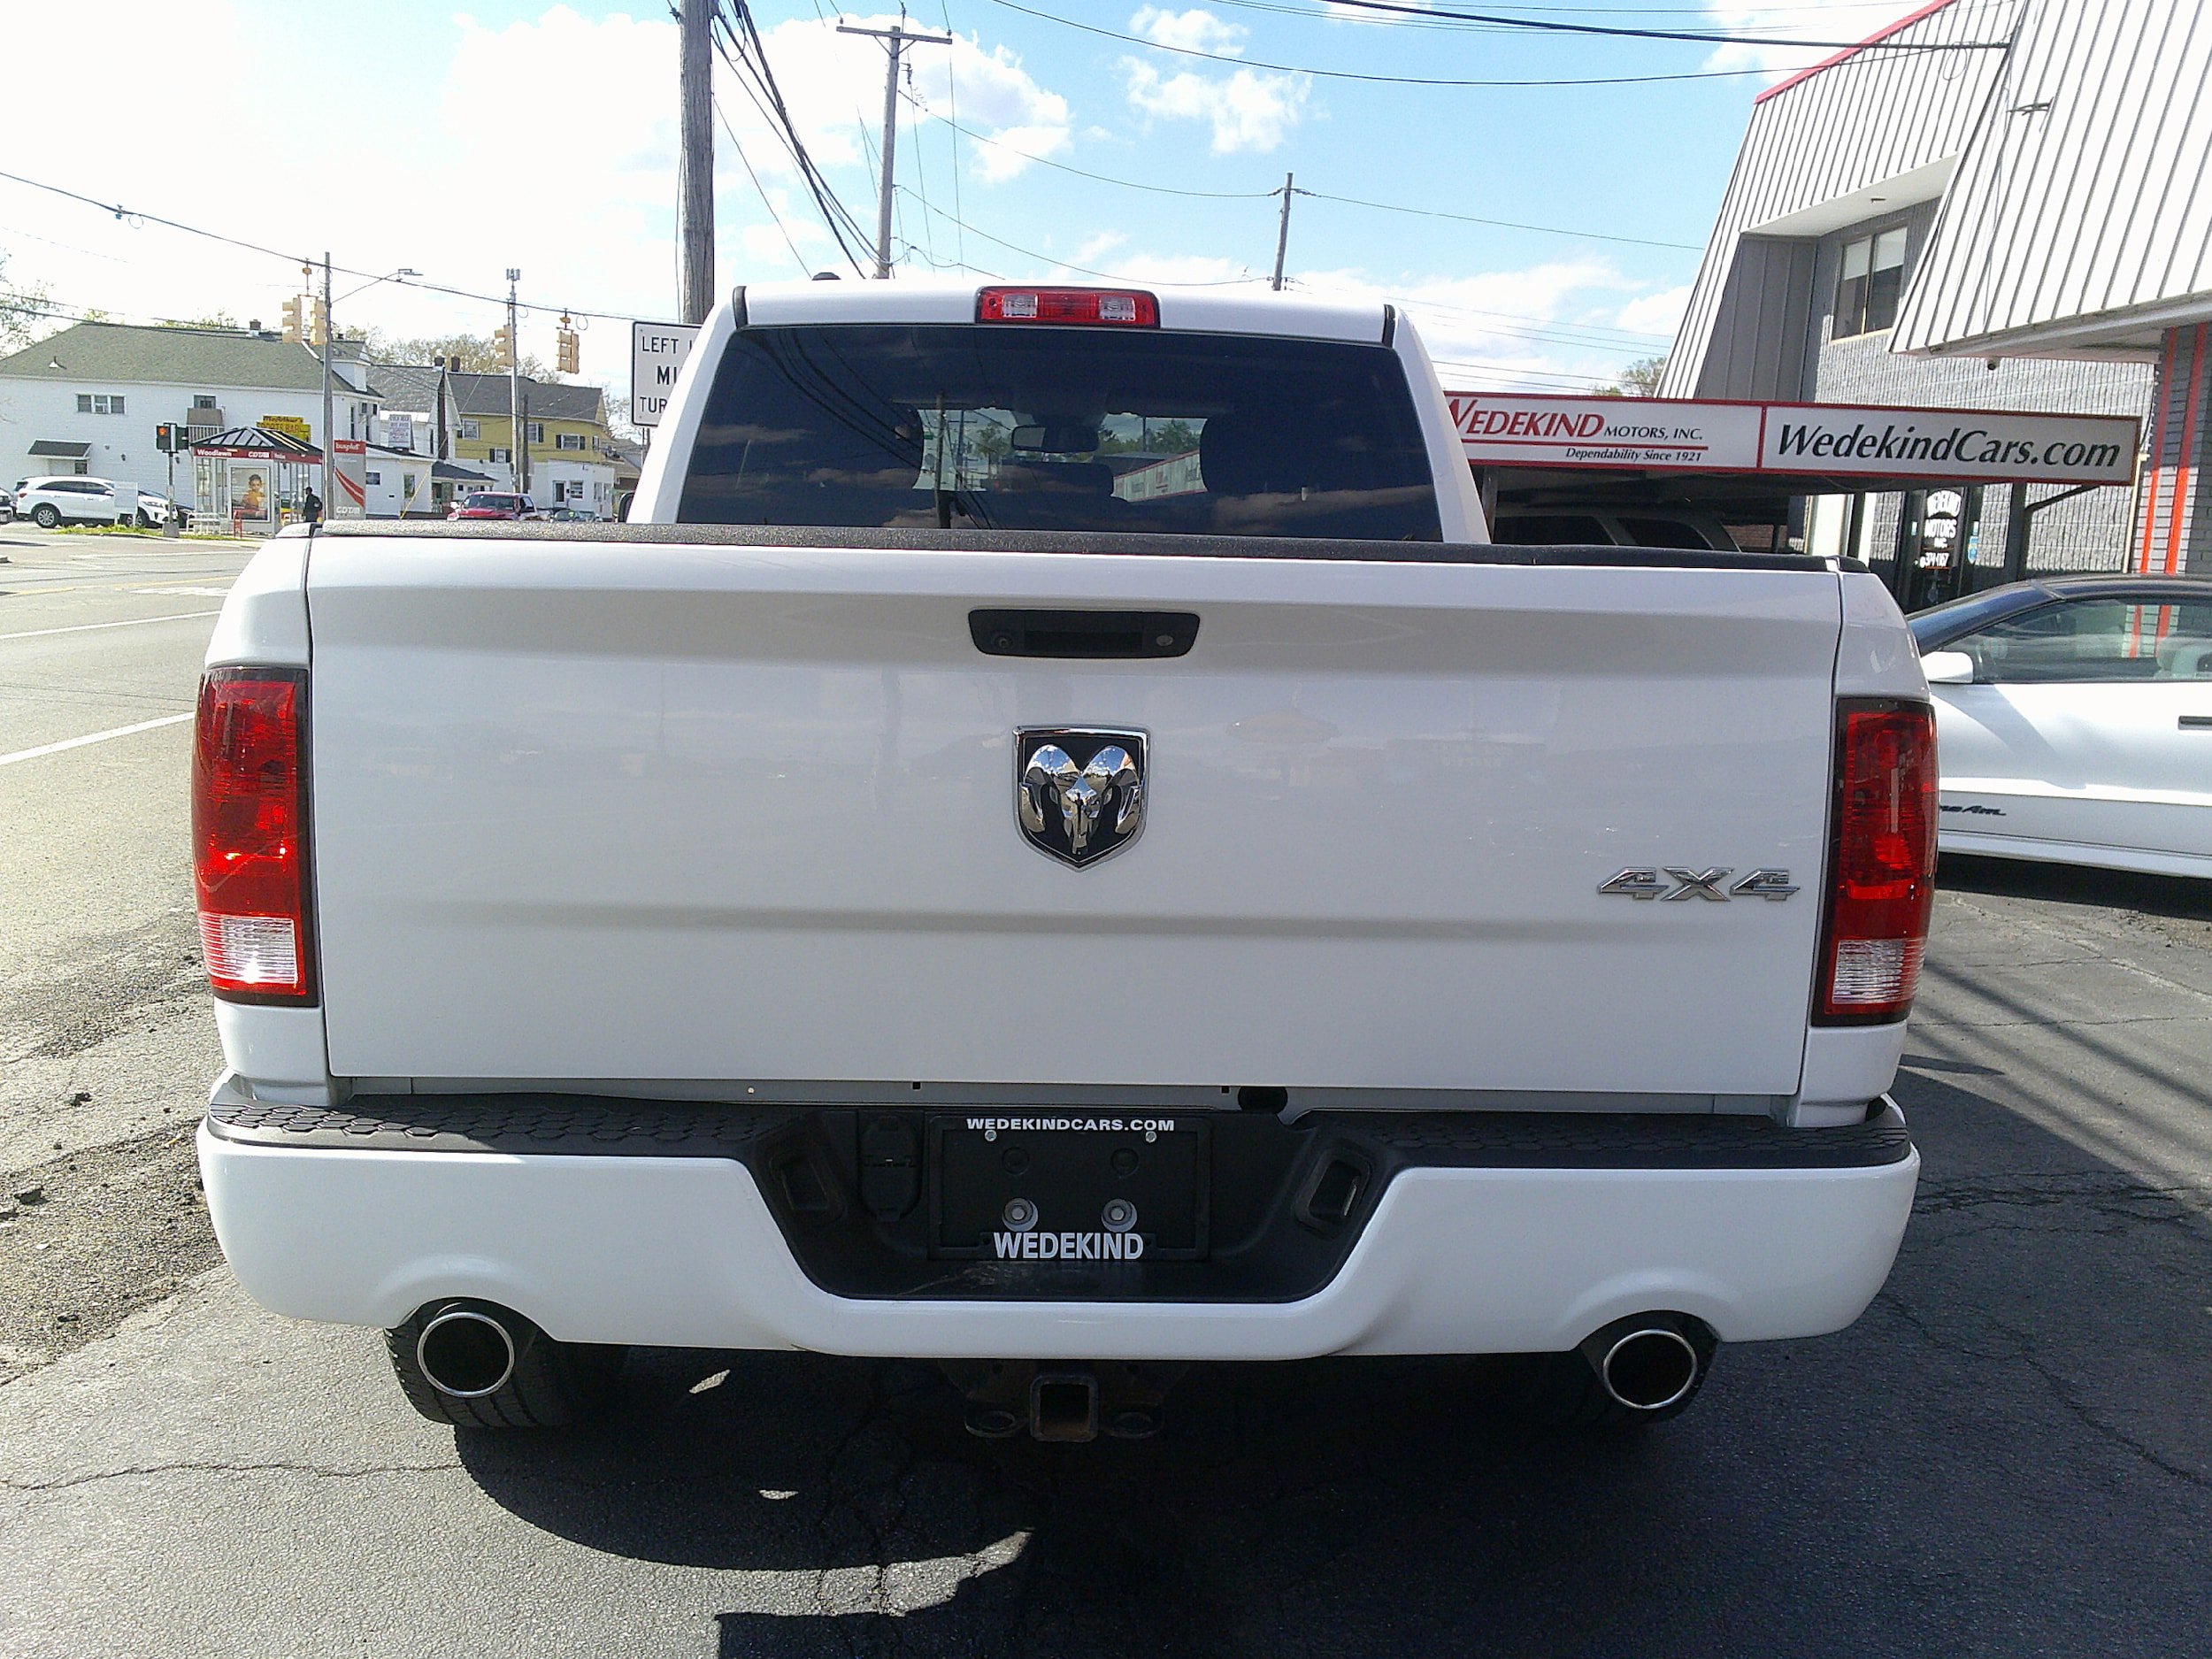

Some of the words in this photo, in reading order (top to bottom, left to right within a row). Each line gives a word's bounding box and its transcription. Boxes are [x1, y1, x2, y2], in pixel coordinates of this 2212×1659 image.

[641, 336, 679, 354] LEFT
[639, 396, 668, 414] TUR
[1603, 426, 1669, 441] MOTORS,
[1673, 428, 1703, 441] INC.
[196, 449, 232, 457] Woodlawn
[1565, 447, 1641, 462] Dependability
[1643, 449, 1672, 461] Since
[1675, 451, 1702, 462] 1921
[1778, 424, 2122, 468] WedekindCars.com
[1924, 518, 1957, 538] MOTORS
[966, 1118, 1175, 1132] WEDEKINDCARS.COM
[993, 1231, 1144, 1261] WEDEKIND
